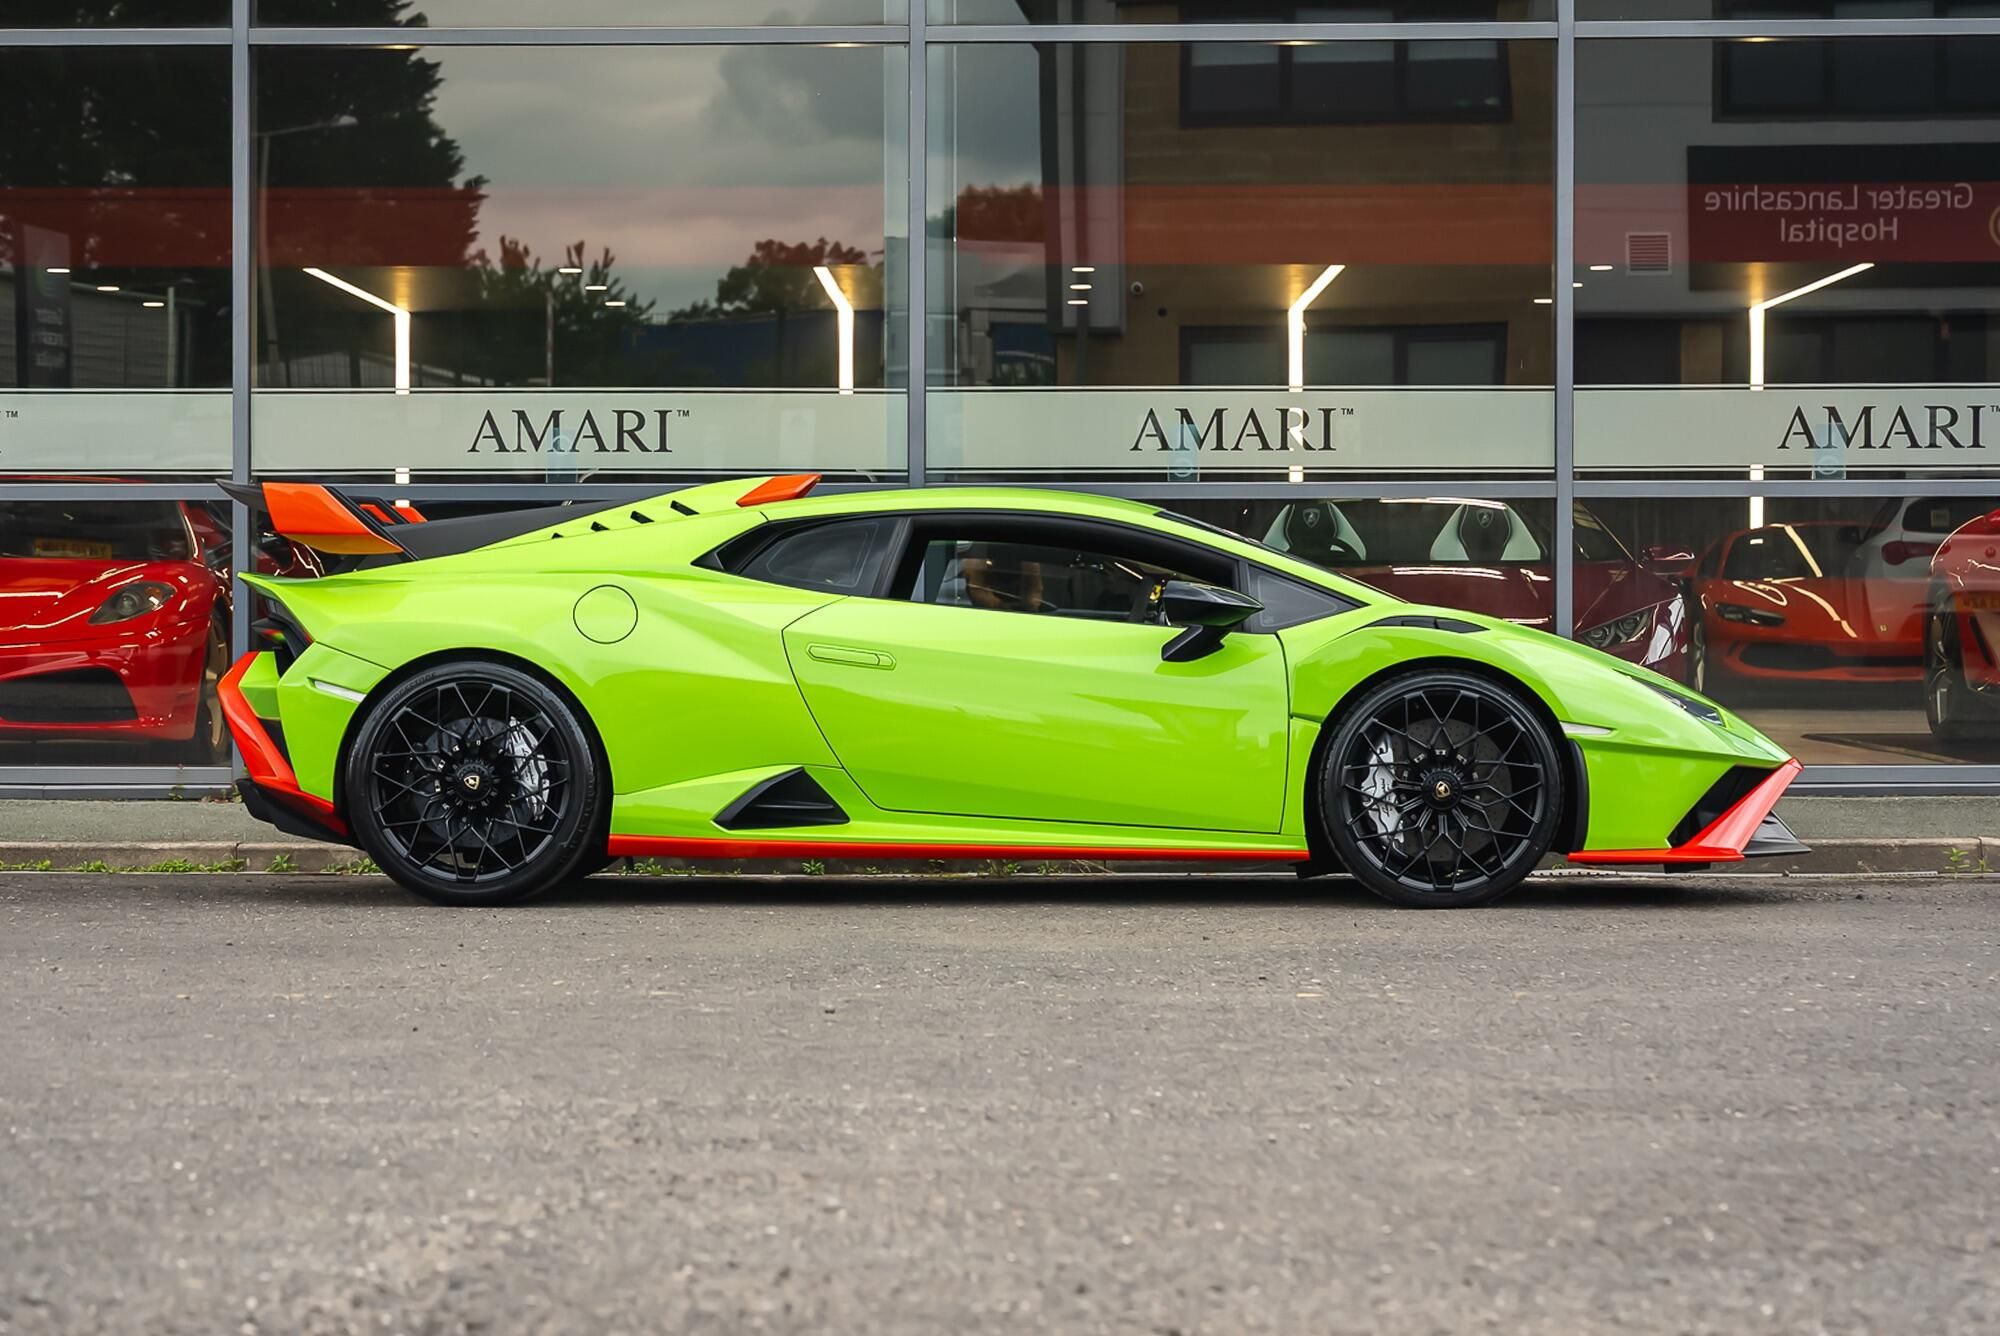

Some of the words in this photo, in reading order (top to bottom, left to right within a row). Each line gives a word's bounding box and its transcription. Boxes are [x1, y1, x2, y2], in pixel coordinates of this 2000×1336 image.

[467, 409, 673, 453] AMARI
[1129, 407, 1337, 451] AMARI
[1776, 404, 1986, 449] AMARI
